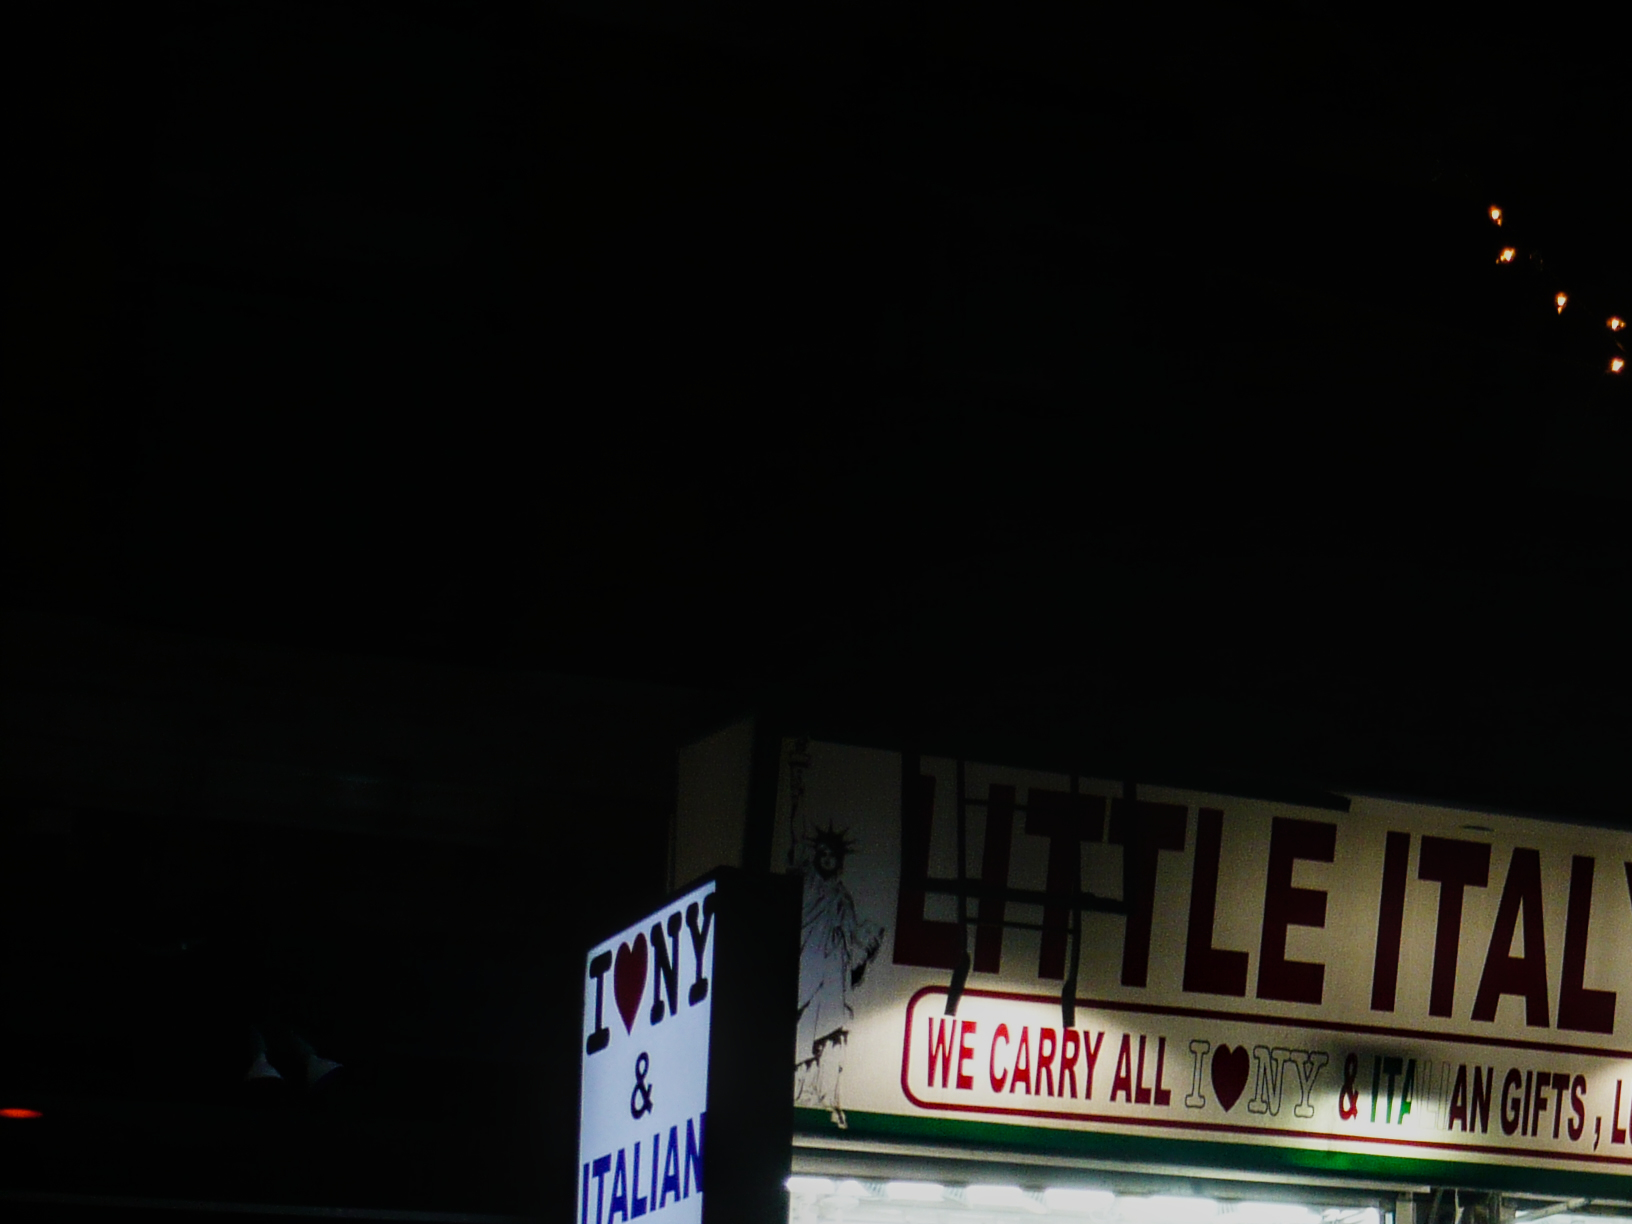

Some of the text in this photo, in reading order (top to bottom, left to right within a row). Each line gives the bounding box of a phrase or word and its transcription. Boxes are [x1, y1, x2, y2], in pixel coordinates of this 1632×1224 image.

[893, 773, 1337, 1005] LITTLE
[586, 891, 716, 1055] I NY
[630, 1051, 653, 1120] &
[927, 1016, 977, 1090] WE
[989, 1022, 1105, 1100] CARRY
[1110, 1033, 1172, 1107] ALL
[1248, 1044, 1330, 1119] NY
[1339, 1052, 1360, 1121] &
